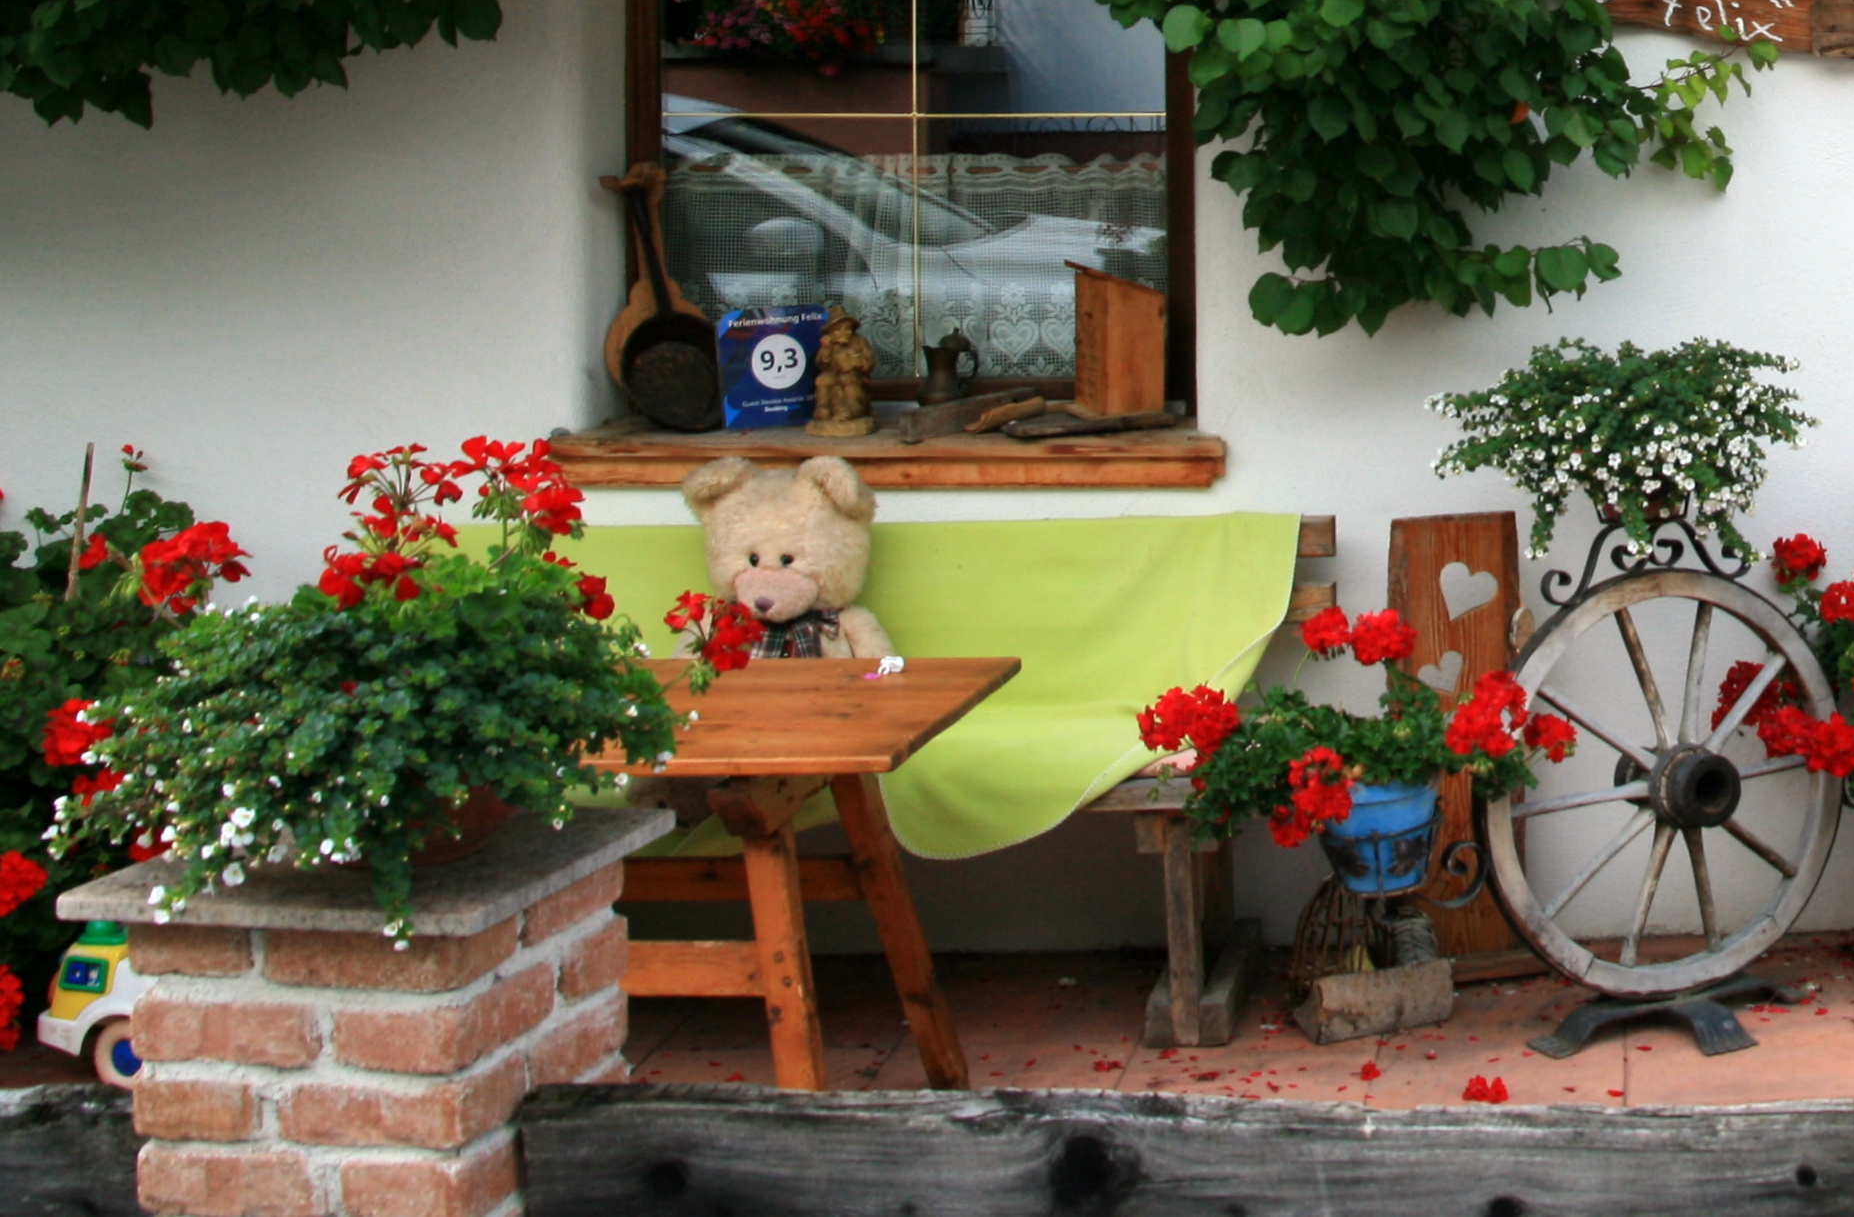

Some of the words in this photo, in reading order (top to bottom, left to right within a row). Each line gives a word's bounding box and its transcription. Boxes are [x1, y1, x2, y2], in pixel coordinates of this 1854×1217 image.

[728, 314, 799, 328] Ferienwohnung
[801, 311, 823, 321] Felix
[760, 347, 798, 373] 9,3
